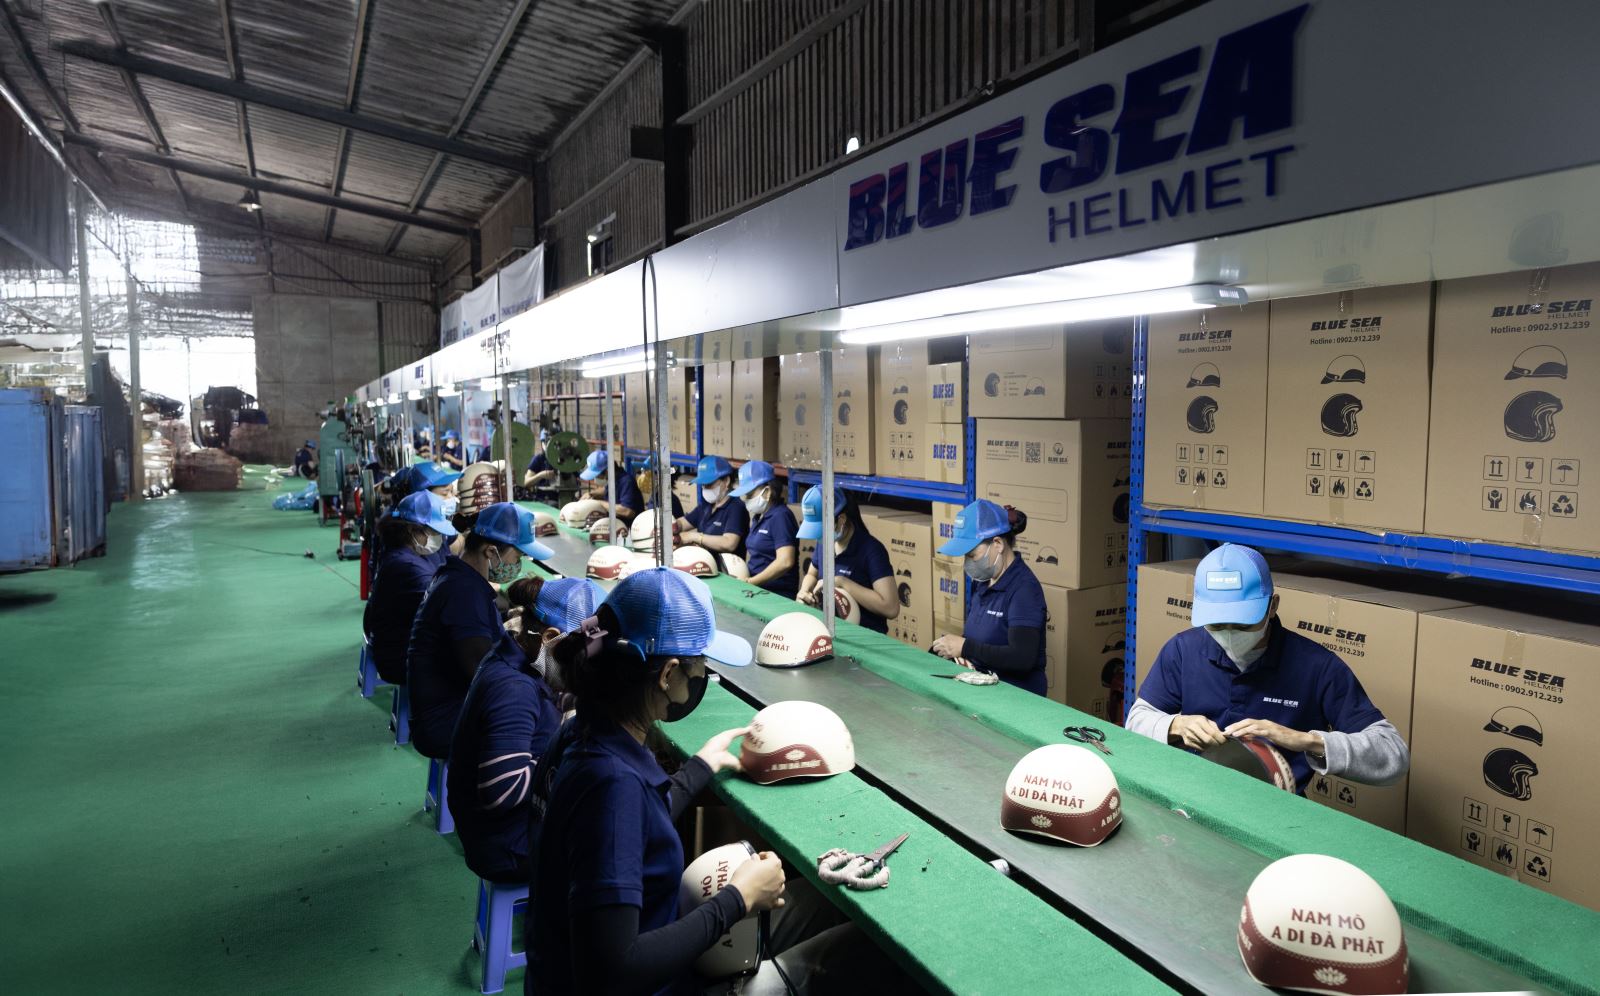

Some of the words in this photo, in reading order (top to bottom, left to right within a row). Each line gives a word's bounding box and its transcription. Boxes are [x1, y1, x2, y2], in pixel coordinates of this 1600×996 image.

[844, 116, 1024, 251] BLUE
[1038, 4, 1313, 194] SEA
[1048, 145, 1296, 243] HELMET
[1491, 303, 1544, 317] BLUE
[1547, 299, 1593, 313] SEA
[1310, 320, 1348, 331] BLUE
[1350, 317, 1382, 328] SEA
[1490, 325, 1521, 334] Hotline
[1527, 321, 1590, 332] 0902.912.239
[1208, 330, 1232, 339] SEA
[1336, 334, 1380, 344] 0902.912.239
[1167, 597, 1193, 609] BLUE
[1297, 620, 1334, 635] BLUE
[1335, 628, 1367, 643] SEA
[1336, 639, 1365, 648] HELMET
[1470, 658, 1521, 677] BLUE
[1523, 669, 1565, 687] SEA
[1470, 676, 1499, 688] Hotline
[1505, 684, 1563, 704] 0902.912.239
[1523, 680, 1563, 693] HELMET
[1024, 774, 1048, 787] NAM
[1019, 788, 1029, 798] DI
[1292, 908, 1332, 926] NAM
[1272, 926, 1282, 940] A
[1288, 928, 1304, 943] DI
[1311, 931, 1336, 949] ĐÀ
[1342, 936, 1384, 957] PHẬT
